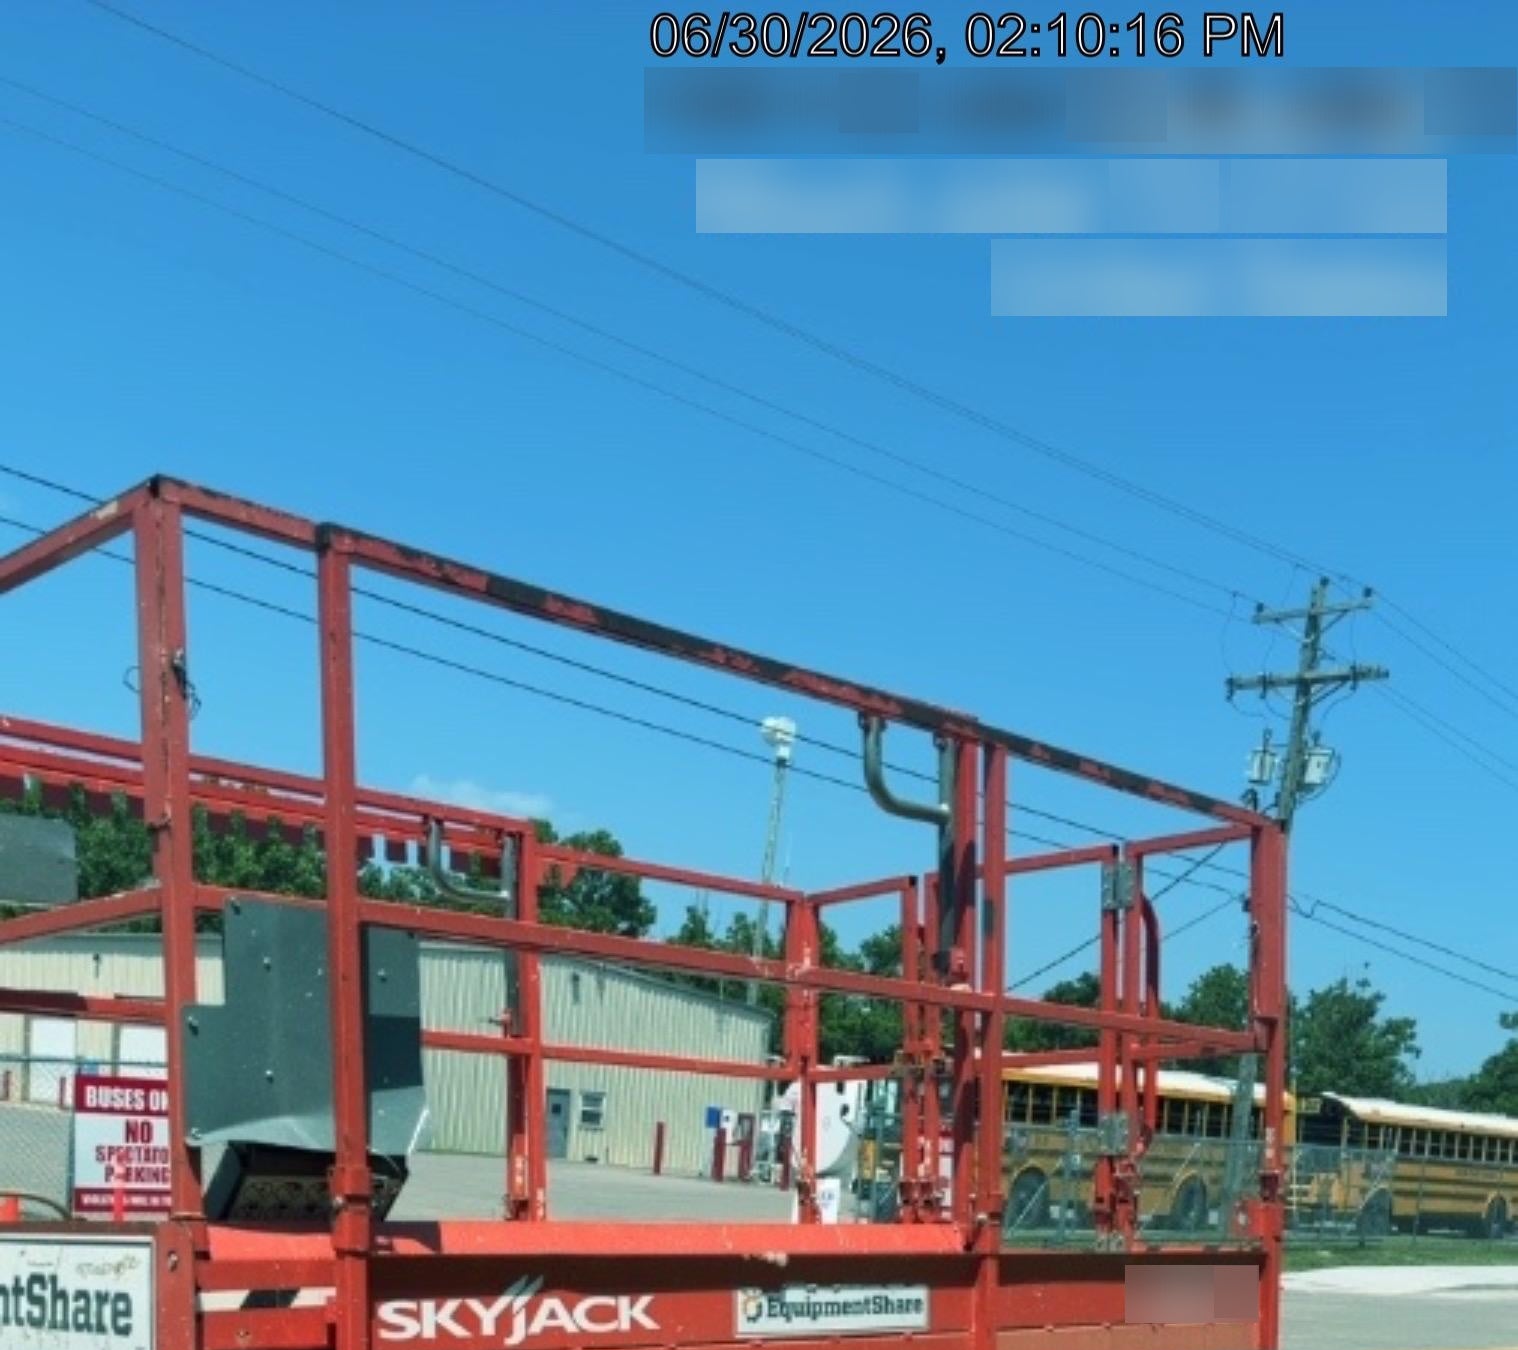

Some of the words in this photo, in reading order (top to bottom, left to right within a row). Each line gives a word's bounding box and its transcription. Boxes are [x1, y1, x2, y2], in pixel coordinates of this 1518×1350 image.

[85, 1085, 145, 1110] BUSES
[126, 1120, 153, 1143] NO
[377, 1274, 660, 1346] SKYJACK
[767, 1296, 923, 1322] EquipmentShare
